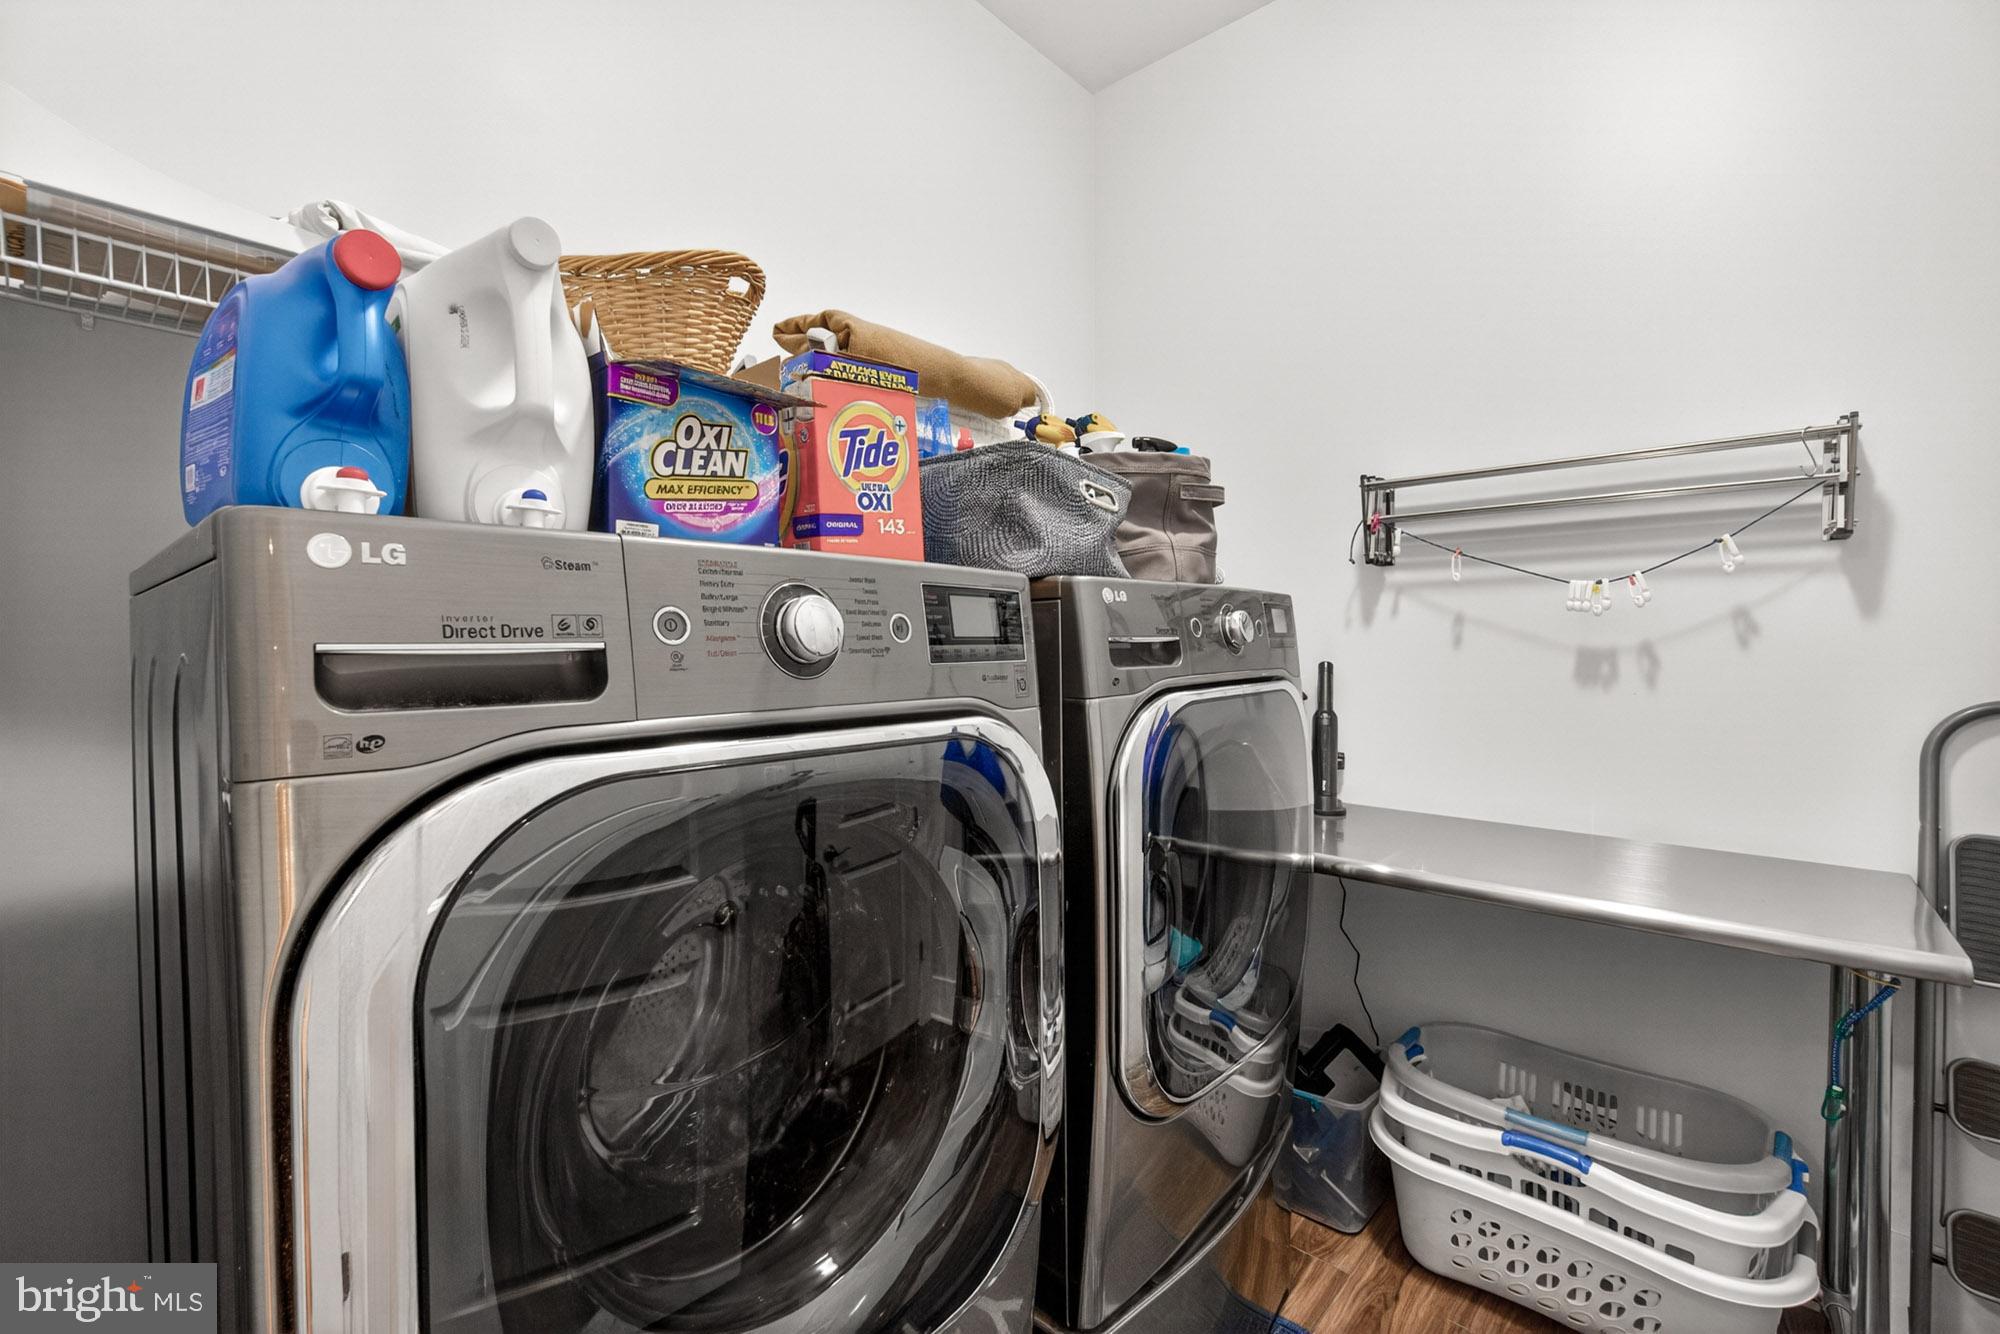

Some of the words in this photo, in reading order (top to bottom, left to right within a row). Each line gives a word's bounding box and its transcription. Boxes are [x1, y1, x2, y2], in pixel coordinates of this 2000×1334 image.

[675, 414, 733, 450] OXI
[652, 440, 748, 478] CLEAN
[838, 427, 900, 478] Tide
[656, 484, 683, 495] MAX
[687, 484, 744, 496] EFFICIENCY
[860, 482, 891, 492] ULTRA
[857, 491, 892, 511] OXI
[825, 520, 859, 530] ORIGINAL
[876, 518, 905, 535] 143
[360, 541, 408, 566] LG
[554, 559, 592, 572] Steam
[440, 614, 494, 623] Inverter
[442, 623, 496, 639] Direct
[501, 624, 545, 639] Drive
